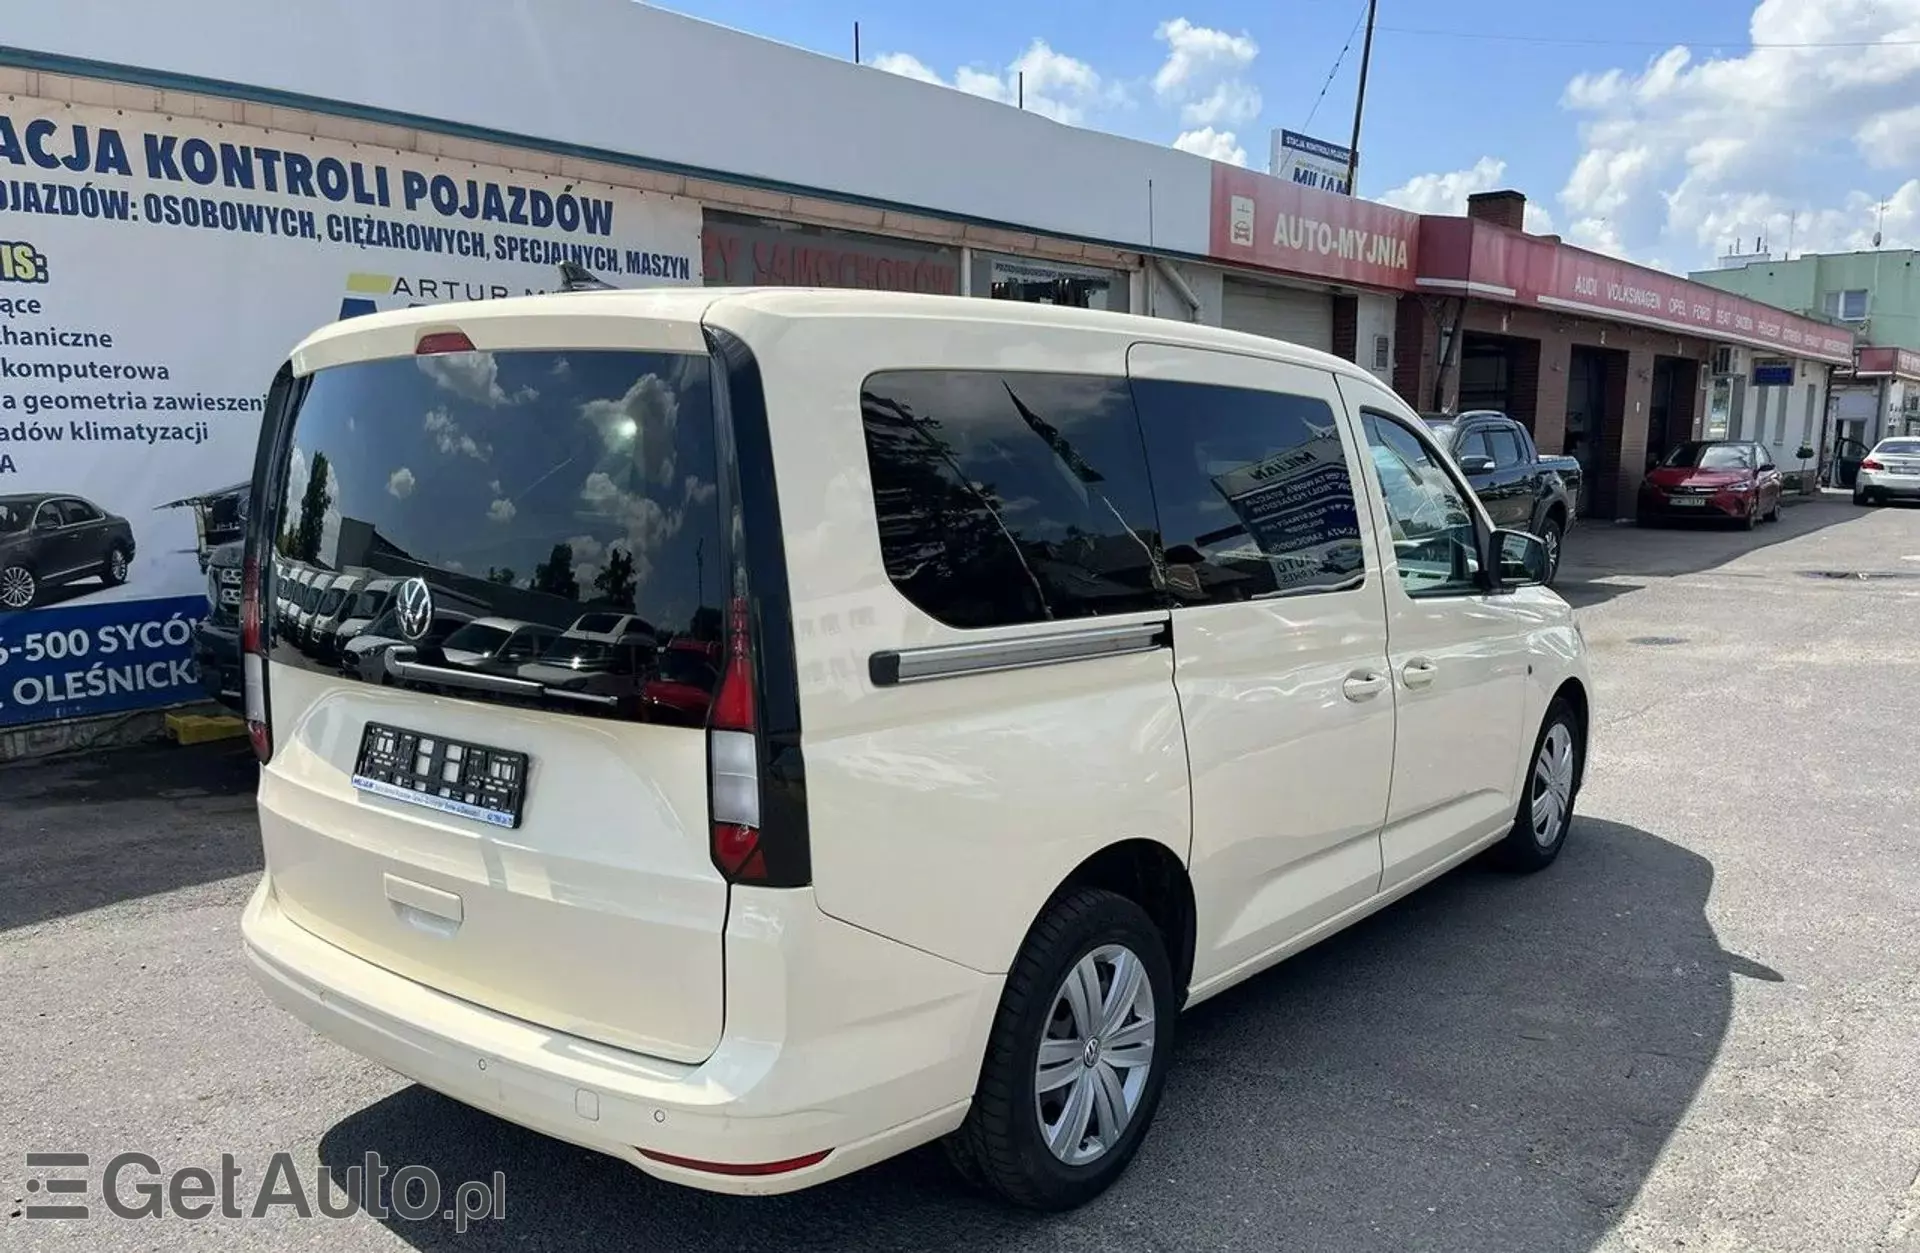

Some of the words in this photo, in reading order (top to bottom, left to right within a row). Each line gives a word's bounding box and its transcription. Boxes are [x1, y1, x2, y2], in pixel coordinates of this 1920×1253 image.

[143, 133, 391, 207] KONTROLI
[402, 168, 614, 236] POJAZDÓW
[144, 193, 322, 242] OSOBOWYCH,
[326, 213, 491, 260] CIĘŻAROWYCH,
[493, 234, 623, 275] SPECJALNYCH,
[626, 250, 690, 281] MASZYN
[1273, 212, 1409, 270] AUTO-MYJNIA
[1575, 274, 1598, 296] AUDI
[1607, 282, 1661, 310] VOLKSWAGEN
[1669, 297, 1686, 316] OPEL
[0, 325, 113, 348] haniczne
[2, 357, 169, 383] komputerowa
[3, 393, 17, 410] a
[23, 391, 147, 414] geometria
[71, 421, 209, 445] klimatyzacji
